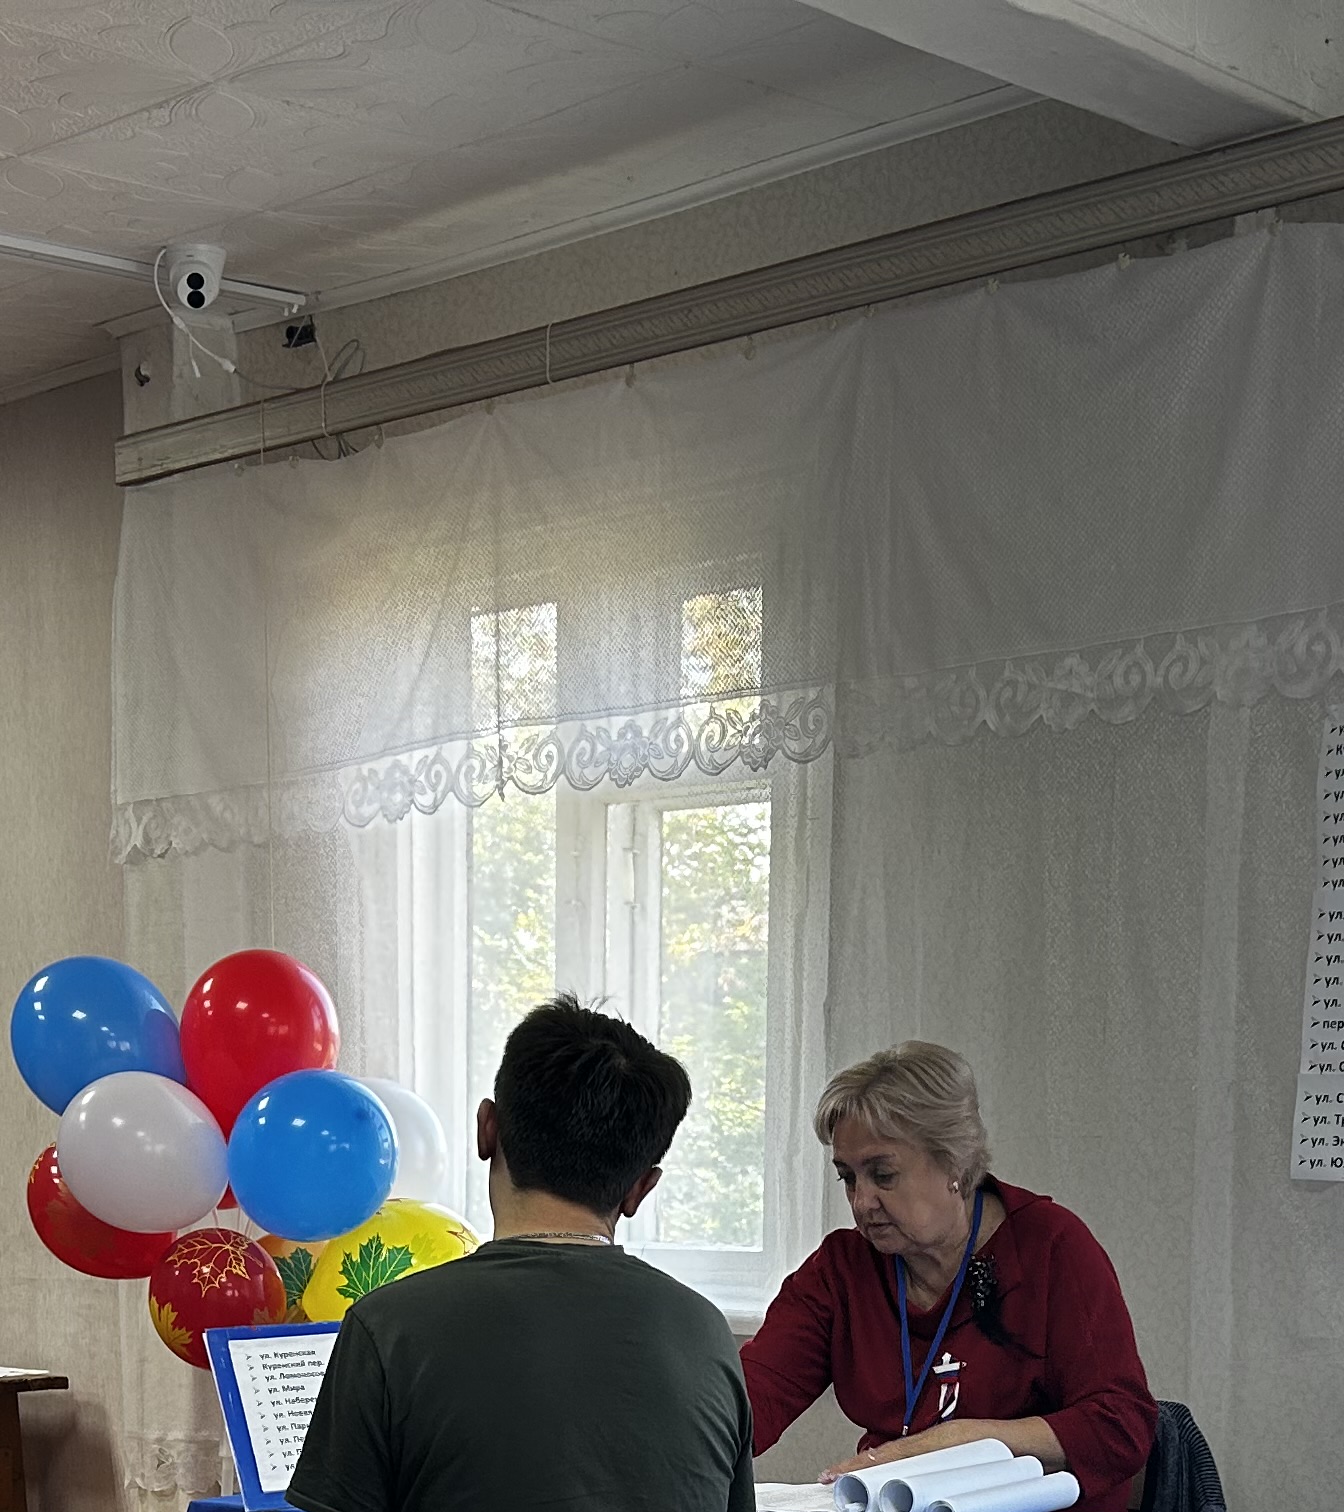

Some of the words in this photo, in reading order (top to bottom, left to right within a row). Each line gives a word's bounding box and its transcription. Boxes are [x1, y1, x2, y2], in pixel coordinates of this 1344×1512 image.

[1327, 932, 1344, 943] ул.
[1326, 954, 1344, 965] ул.
[1325, 976, 1343, 987] ул.
[1323, 998, 1341, 1009] ул.
[1320, 1041, 1337, 1053] ул.
[1319, 1062, 1336, 1074] ул.
[1315, 1094, 1332, 1105] ул.
[1313, 1115, 1330, 1126] ул.
[1311, 1137, 1329, 1148] ул.
[1309, 1158, 1327, 1169] ул.
[285, 1397, 317, 1405] Набере
